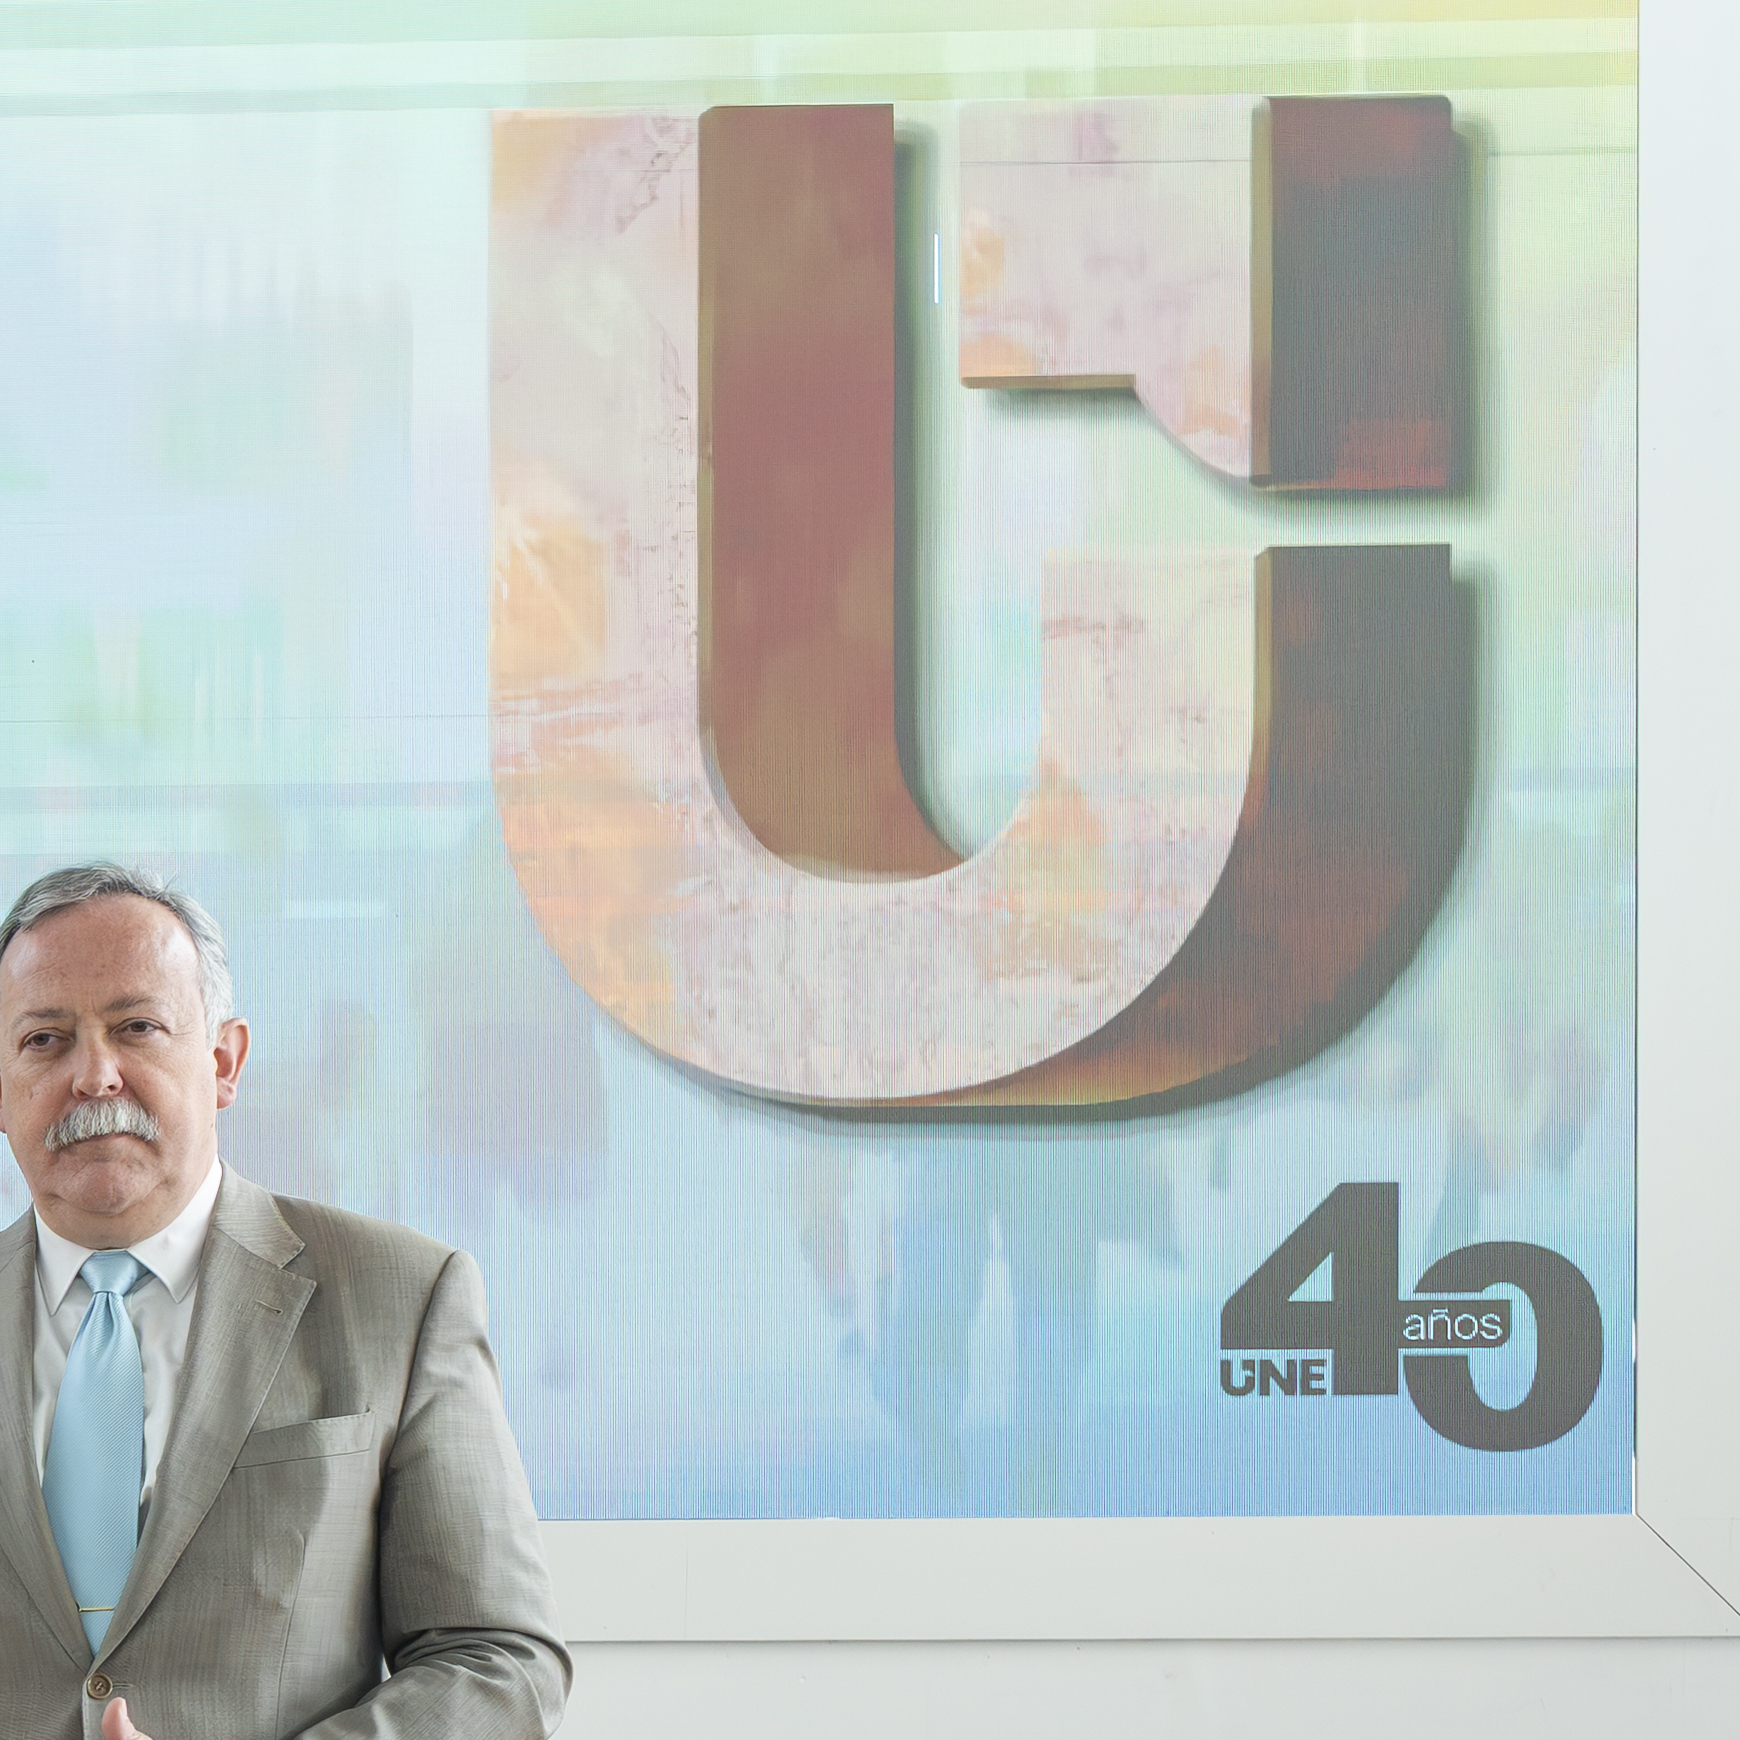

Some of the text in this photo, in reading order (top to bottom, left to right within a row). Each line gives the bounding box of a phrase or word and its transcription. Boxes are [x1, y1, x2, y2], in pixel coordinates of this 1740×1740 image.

[1220, 1182, 1603, 1453] 40
[1402, 1308, 1503, 1341] años
[1220, 1359, 1327, 1397] UNE
